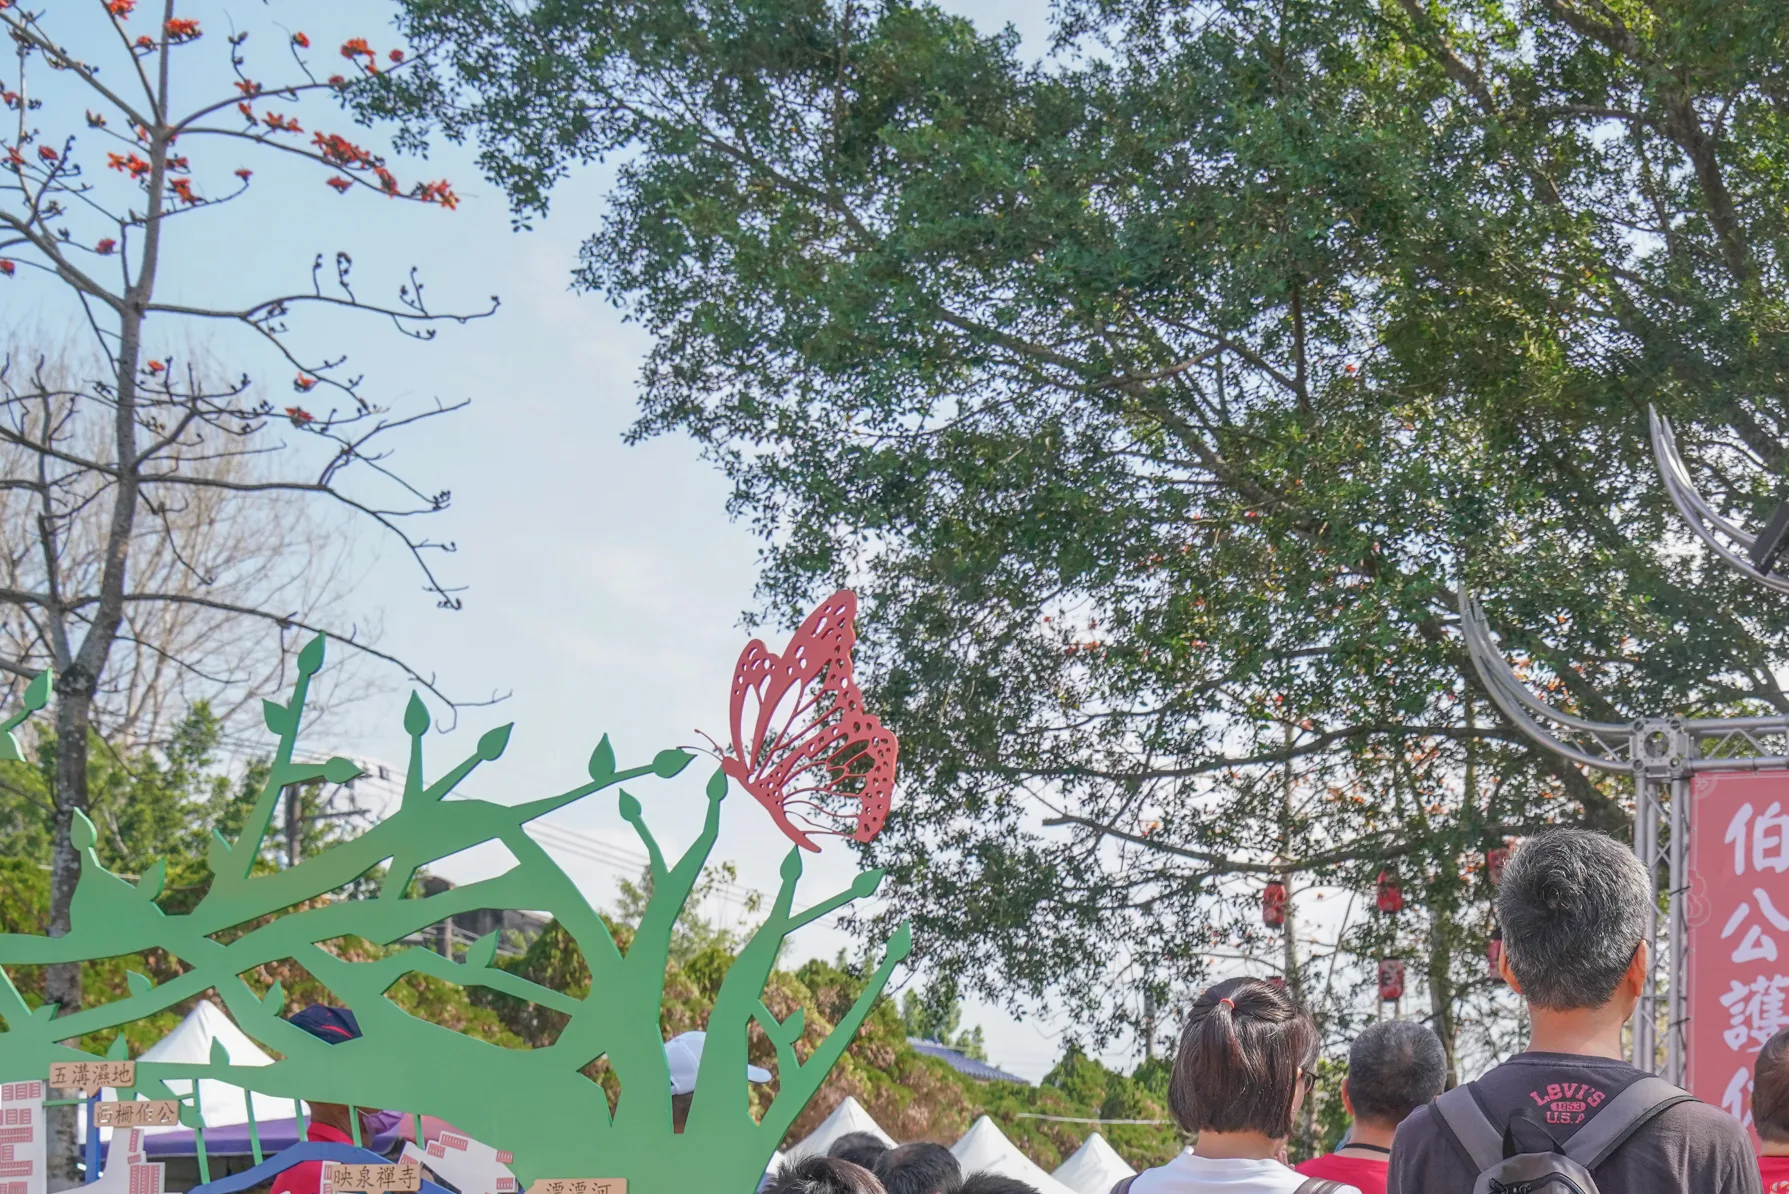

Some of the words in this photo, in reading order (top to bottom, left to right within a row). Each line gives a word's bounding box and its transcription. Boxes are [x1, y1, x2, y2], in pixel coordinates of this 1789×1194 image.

[51, 1062, 133, 1086] 五溝濕地
[1554, 1102, 1583, 1112] 1853
[333, 1165, 417, 1189] 映泉禪寺
